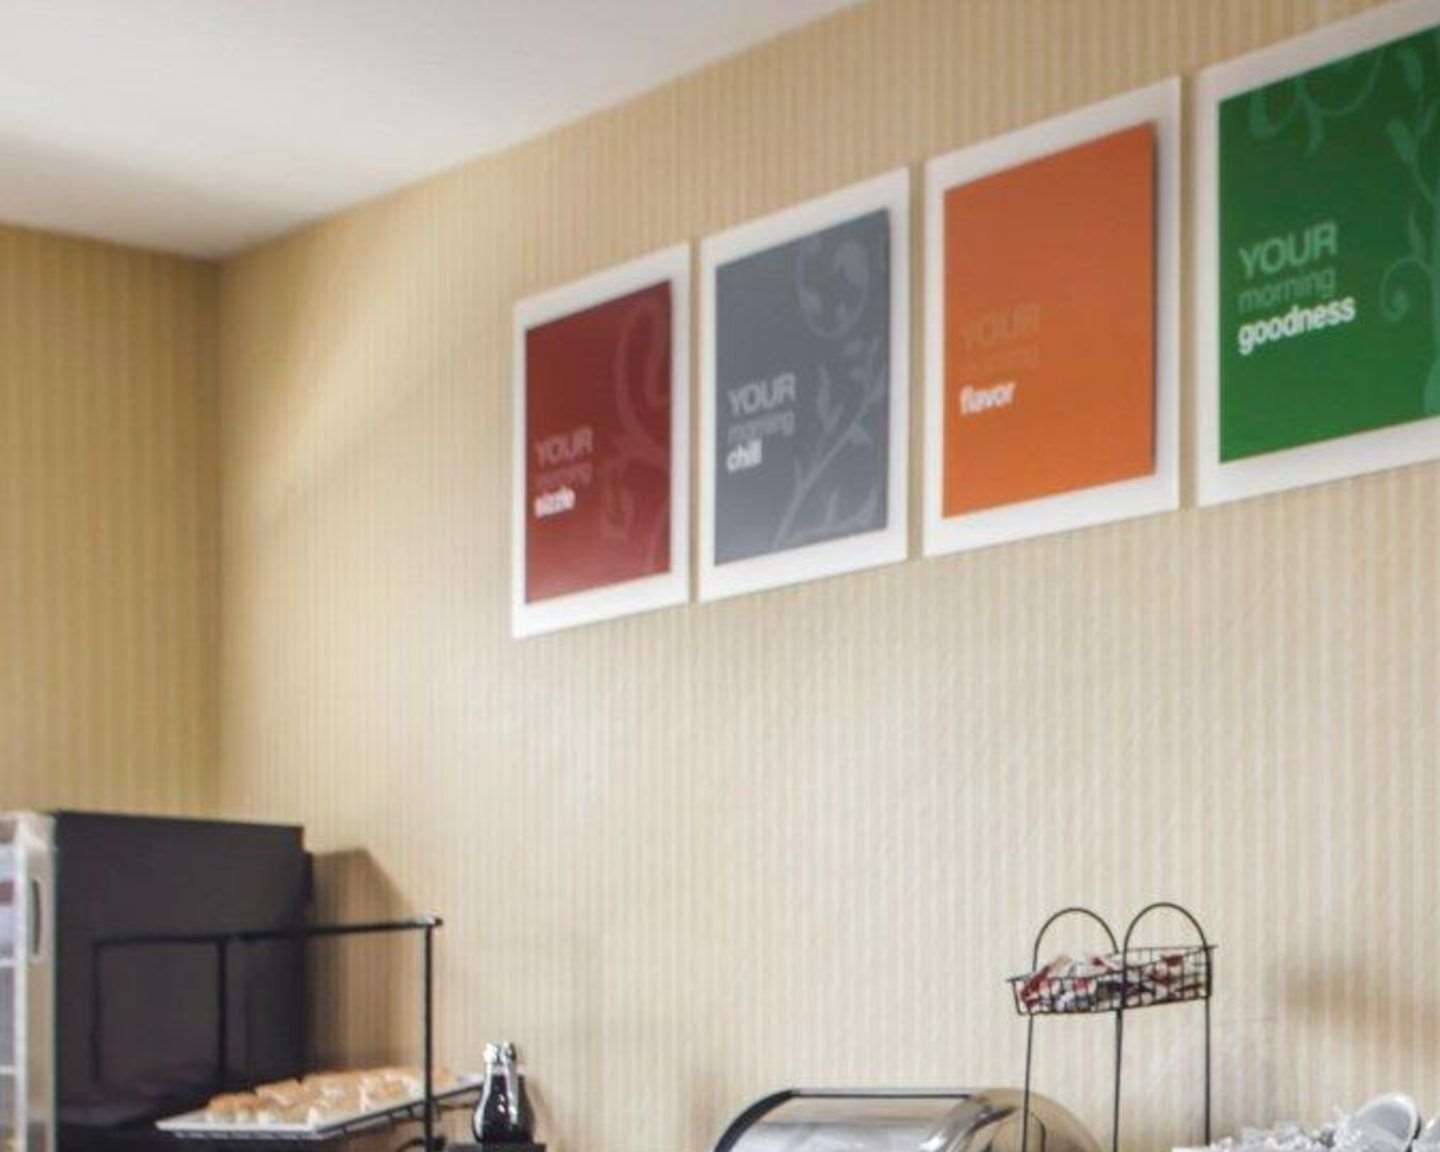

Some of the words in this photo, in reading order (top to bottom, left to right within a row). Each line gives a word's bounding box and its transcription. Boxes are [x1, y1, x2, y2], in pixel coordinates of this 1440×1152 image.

[1237, 220, 1339, 279] YOUR
[1238, 267, 1337, 312] morning
[1238, 296, 1356, 355] goodness
[727, 372, 797, 418] YOUR
